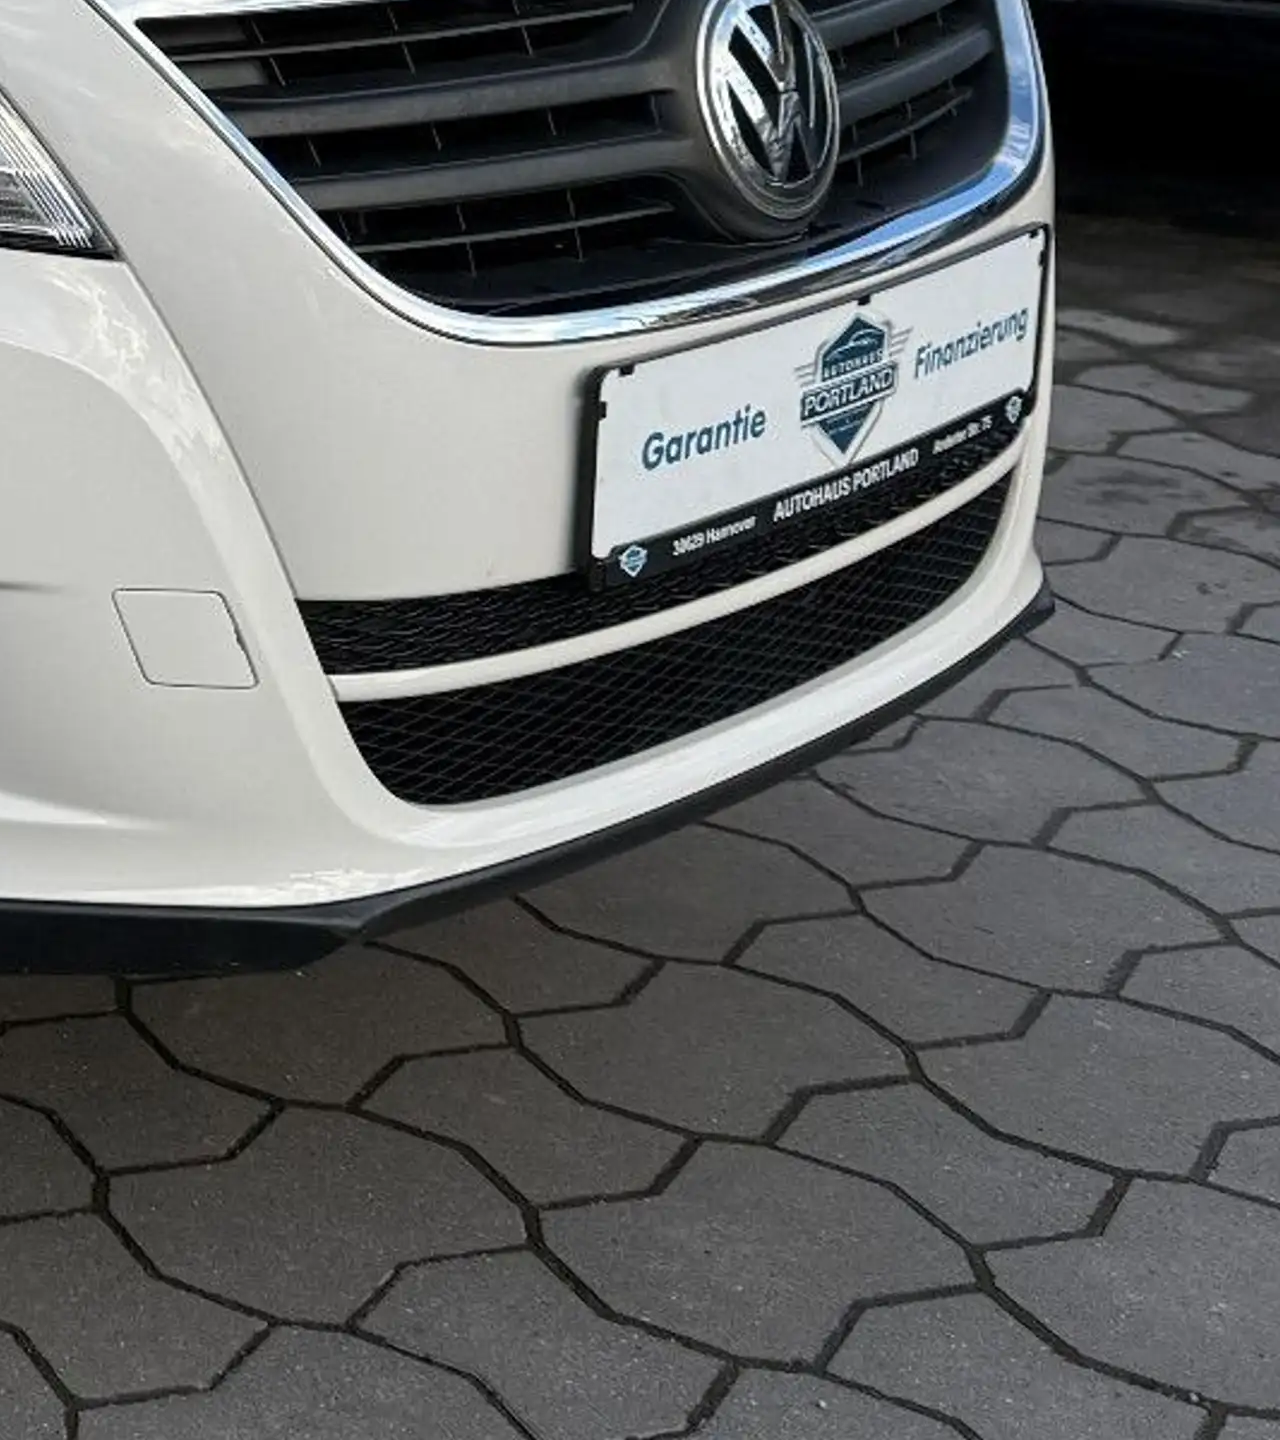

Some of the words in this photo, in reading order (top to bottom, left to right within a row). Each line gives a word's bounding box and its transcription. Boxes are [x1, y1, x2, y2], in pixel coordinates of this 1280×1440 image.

[914, 307, 1029, 380] Finanzierung
[803, 368, 894, 417] PORTLAND
[641, 402, 767, 472] Garantie
[773, 476, 851, 522] AUTOHAUS
[852, 447, 920, 493] PORTLAND
